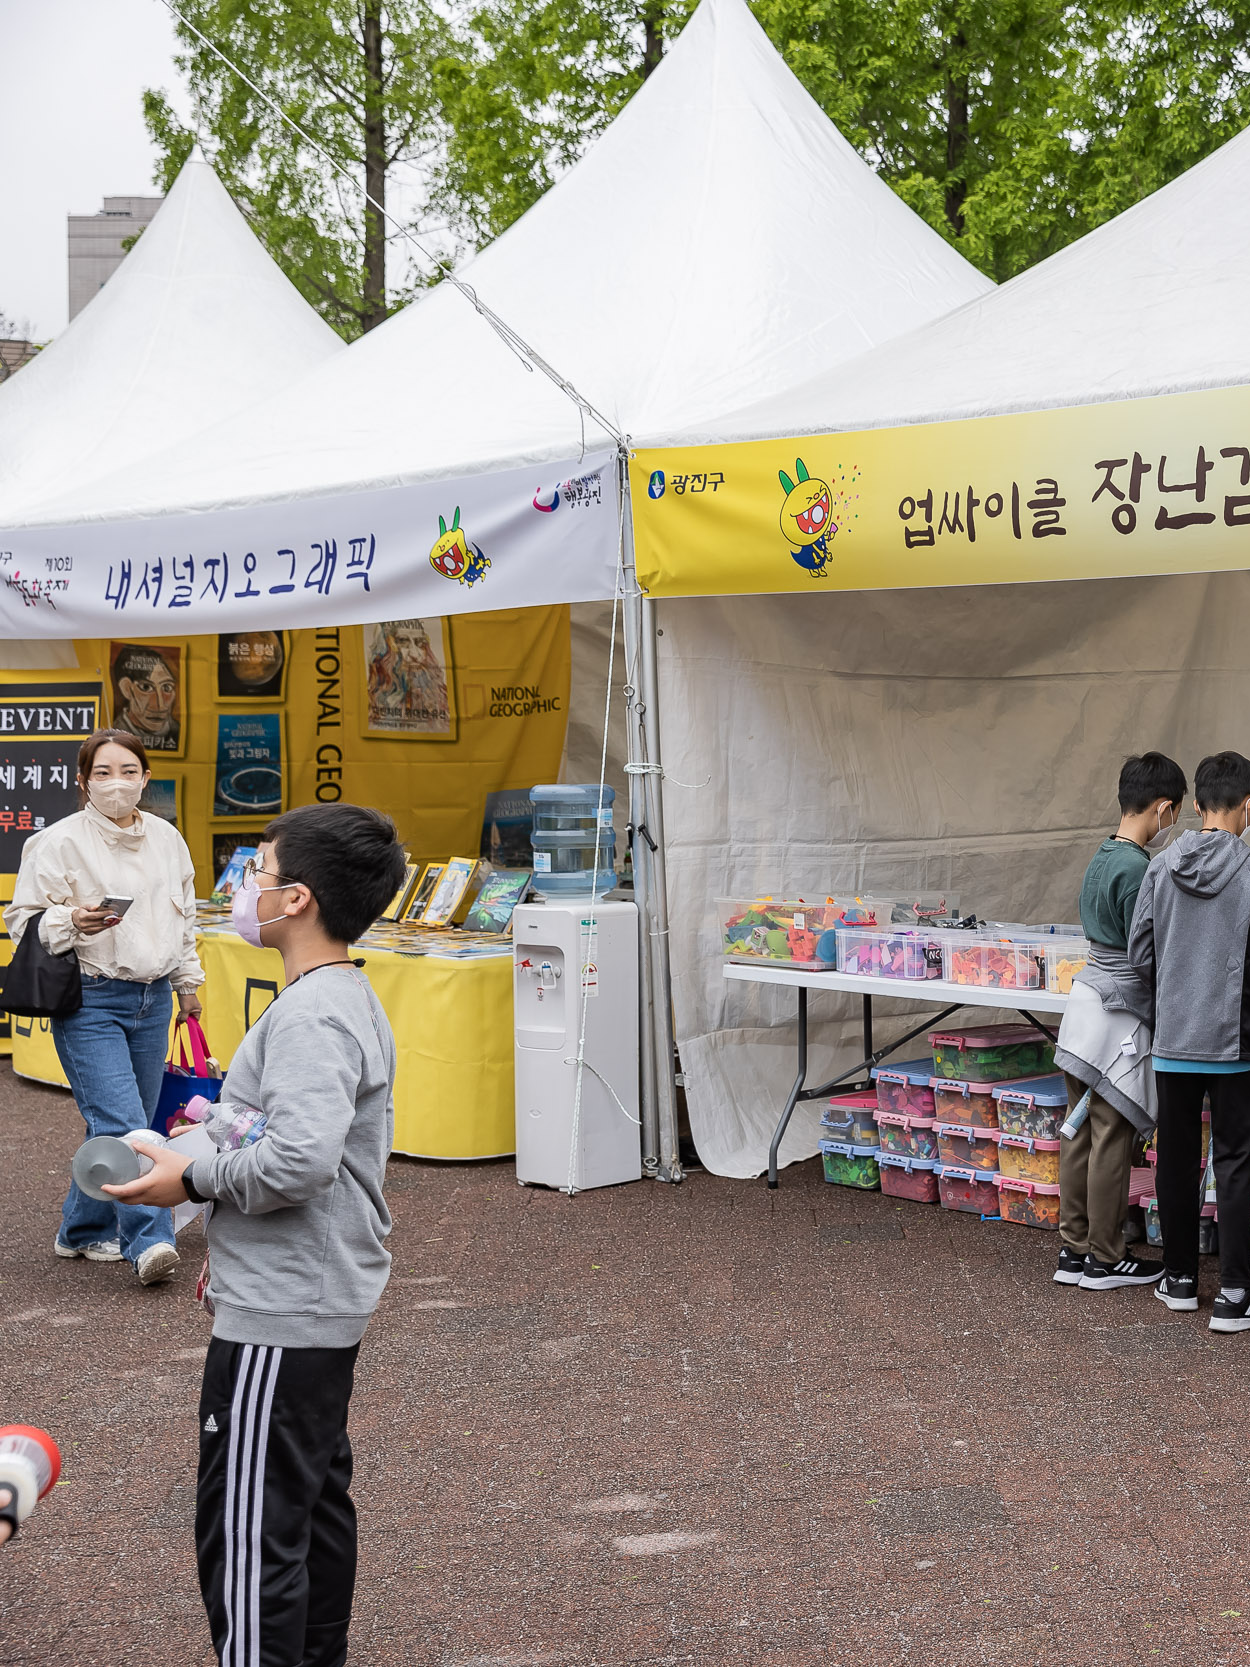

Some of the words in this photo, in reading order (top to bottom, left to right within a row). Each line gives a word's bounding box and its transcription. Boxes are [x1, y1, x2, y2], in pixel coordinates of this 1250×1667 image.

[670, 472, 725, 495] 광진구
[898, 478, 1067, 549] 업싸이클
[104, 533, 377, 611] 내셔널지오그래픽
[228, 642, 251, 656] 붉은
[315, 627, 341, 737] TIONAL
[0, 707, 95, 731] EVENT
[144, 736, 177, 750] 피카소
[0, 764, 79, 790] 세계지
